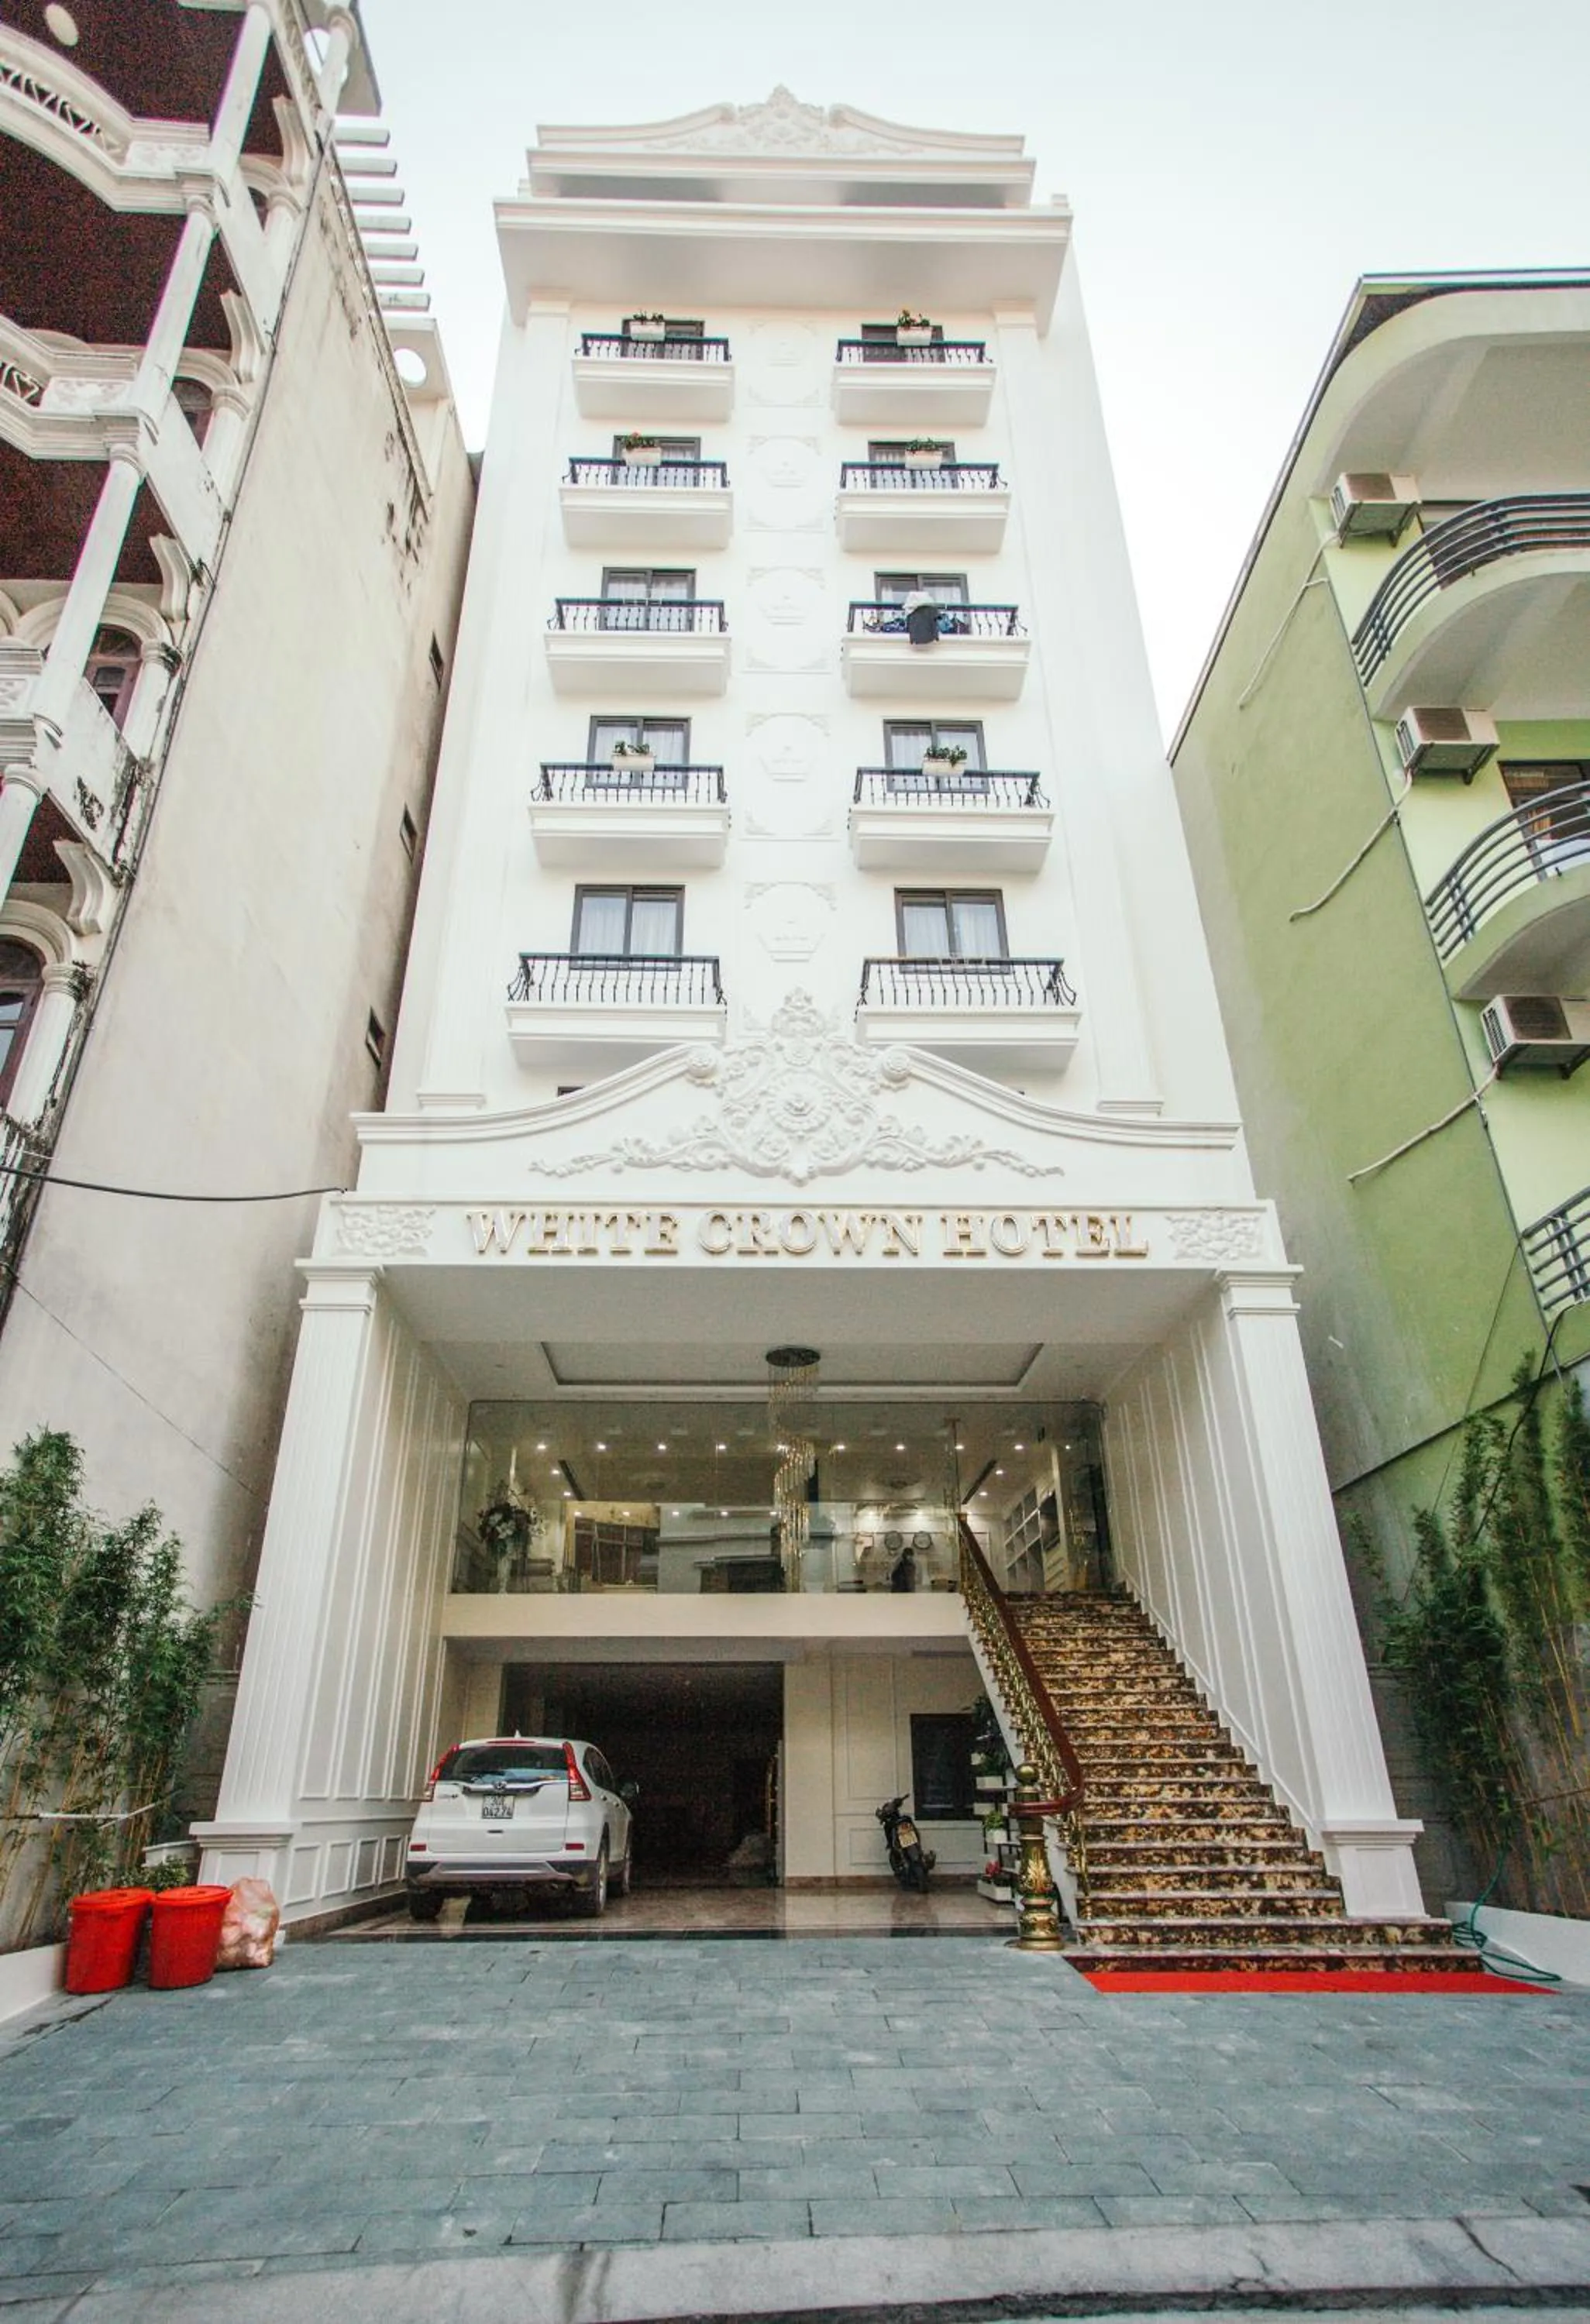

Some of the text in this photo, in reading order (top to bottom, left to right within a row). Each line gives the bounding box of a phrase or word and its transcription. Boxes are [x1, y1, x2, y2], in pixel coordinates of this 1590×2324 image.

[466, 1209, 1148, 1257] WHITE CROWN HOTEL
